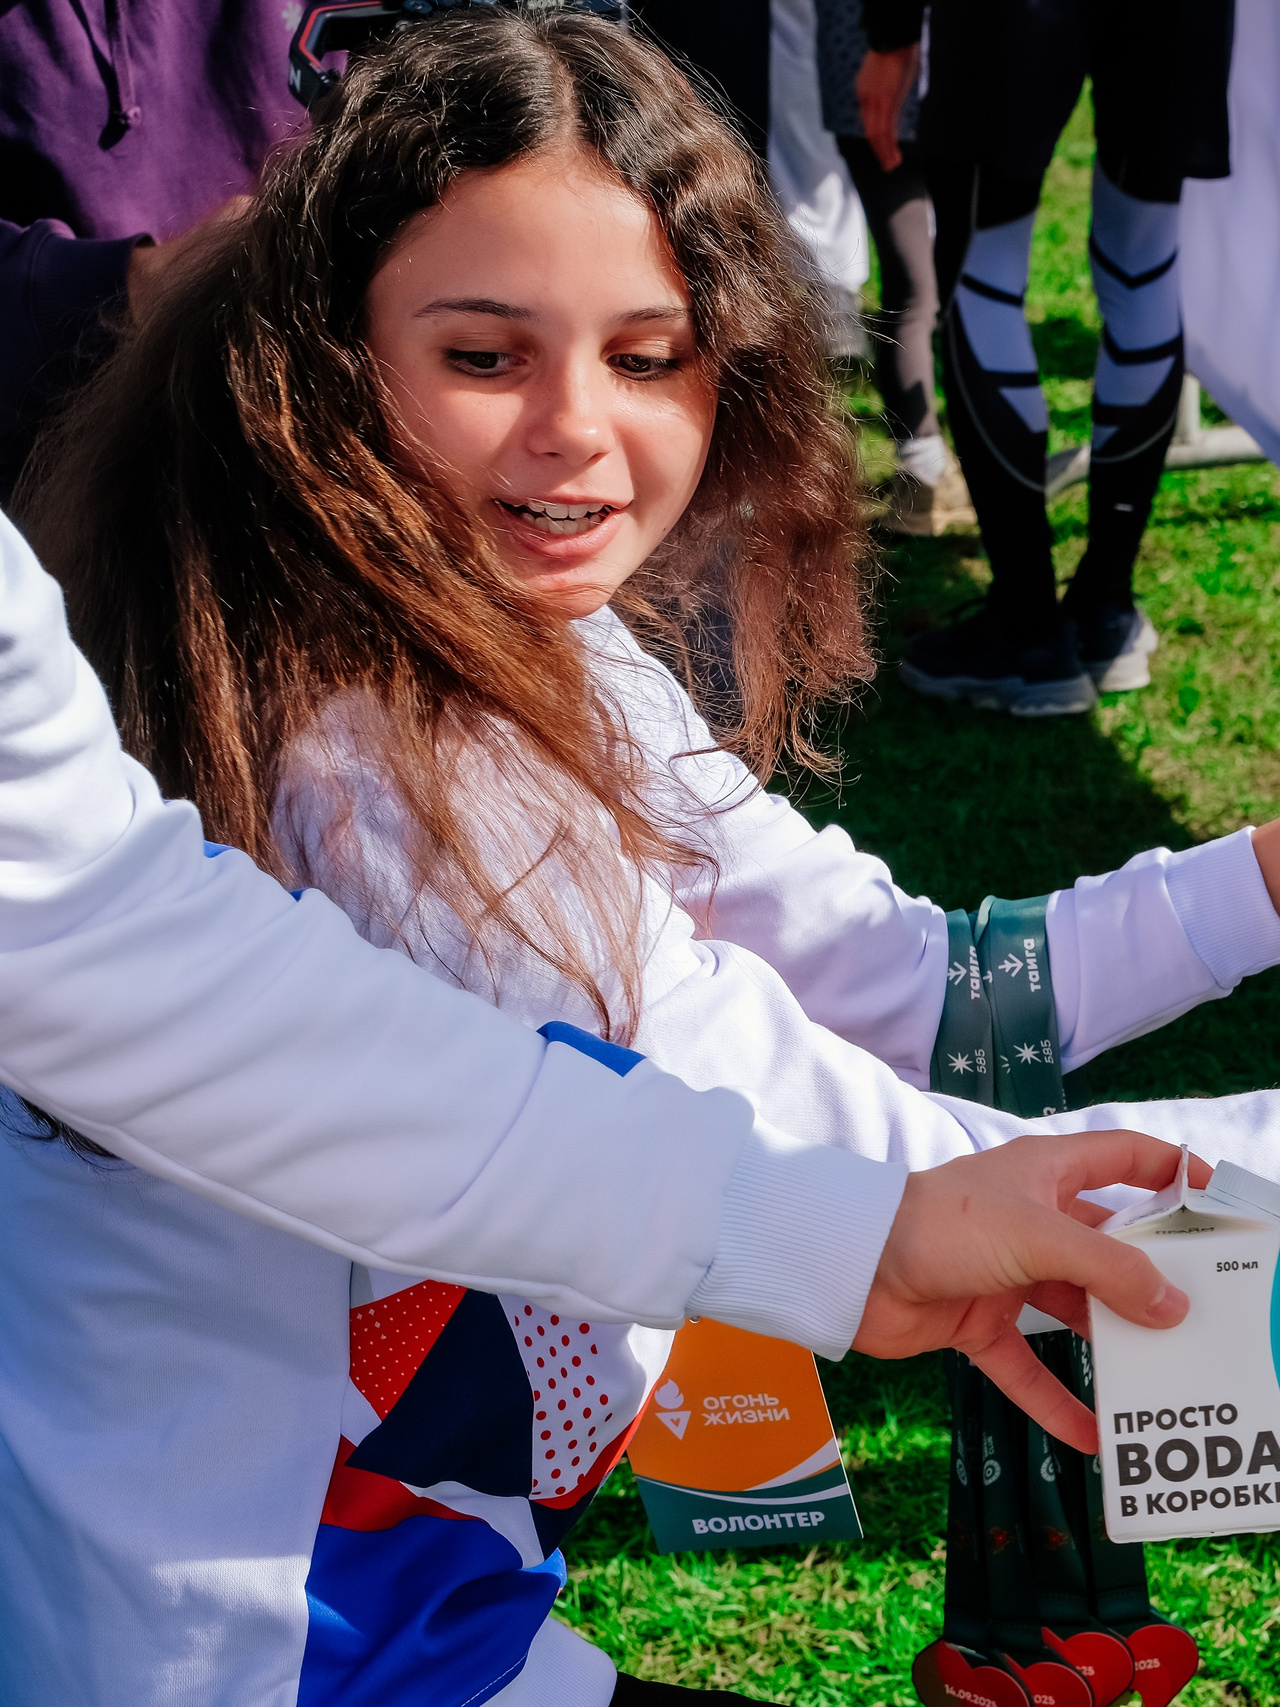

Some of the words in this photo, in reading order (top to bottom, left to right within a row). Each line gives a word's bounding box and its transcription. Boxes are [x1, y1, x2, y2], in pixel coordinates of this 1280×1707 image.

[974, 1048, 987, 1074] 585
[1040, 1039, 1055, 1064] 585
[1216, 1260, 1239, 1273] 500
[1241, 1260, 1259, 1271] мл
[702, 1393, 780, 1410] ОГОНЬ
[701, 1407, 790, 1427] ЖИЗНИ
[1113, 1402, 1239, 1435] ПРОСТО
[1120, 1495, 1139, 1518] В
[691, 1510, 826, 1535] ВОЛОНТЕР
